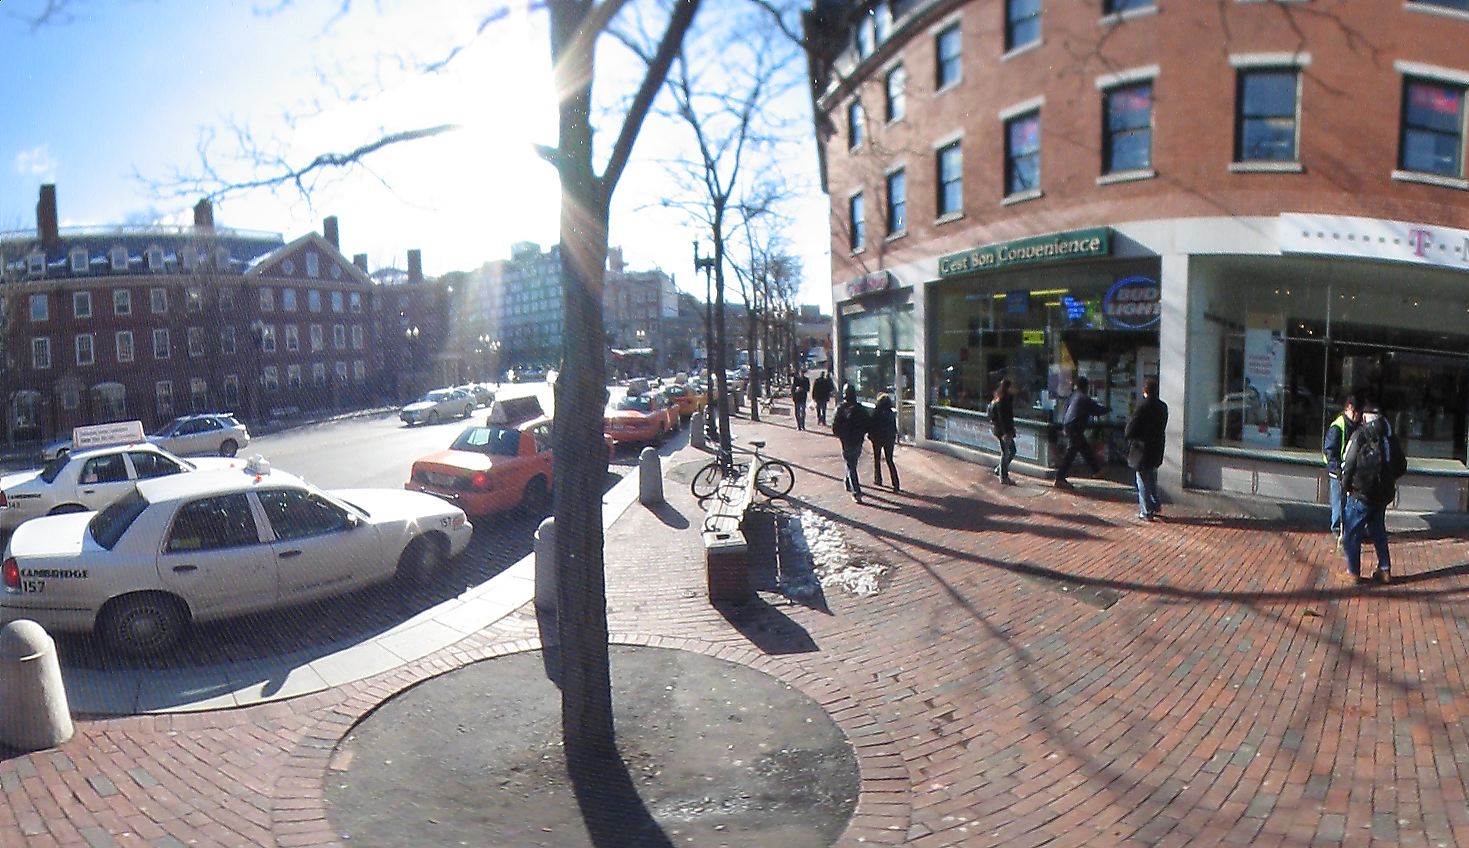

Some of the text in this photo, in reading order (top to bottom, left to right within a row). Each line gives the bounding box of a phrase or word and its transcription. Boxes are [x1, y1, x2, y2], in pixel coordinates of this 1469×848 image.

[1408, 228, 1432, 257] T
[972, 251, 995, 267] Bon
[998, 235, 1101, 261] Convenience
[1116, 287, 1158, 300] BUD
[21, 568, 88, 579] CAMBRIDGE
[22, 580, 46, 593] 157
